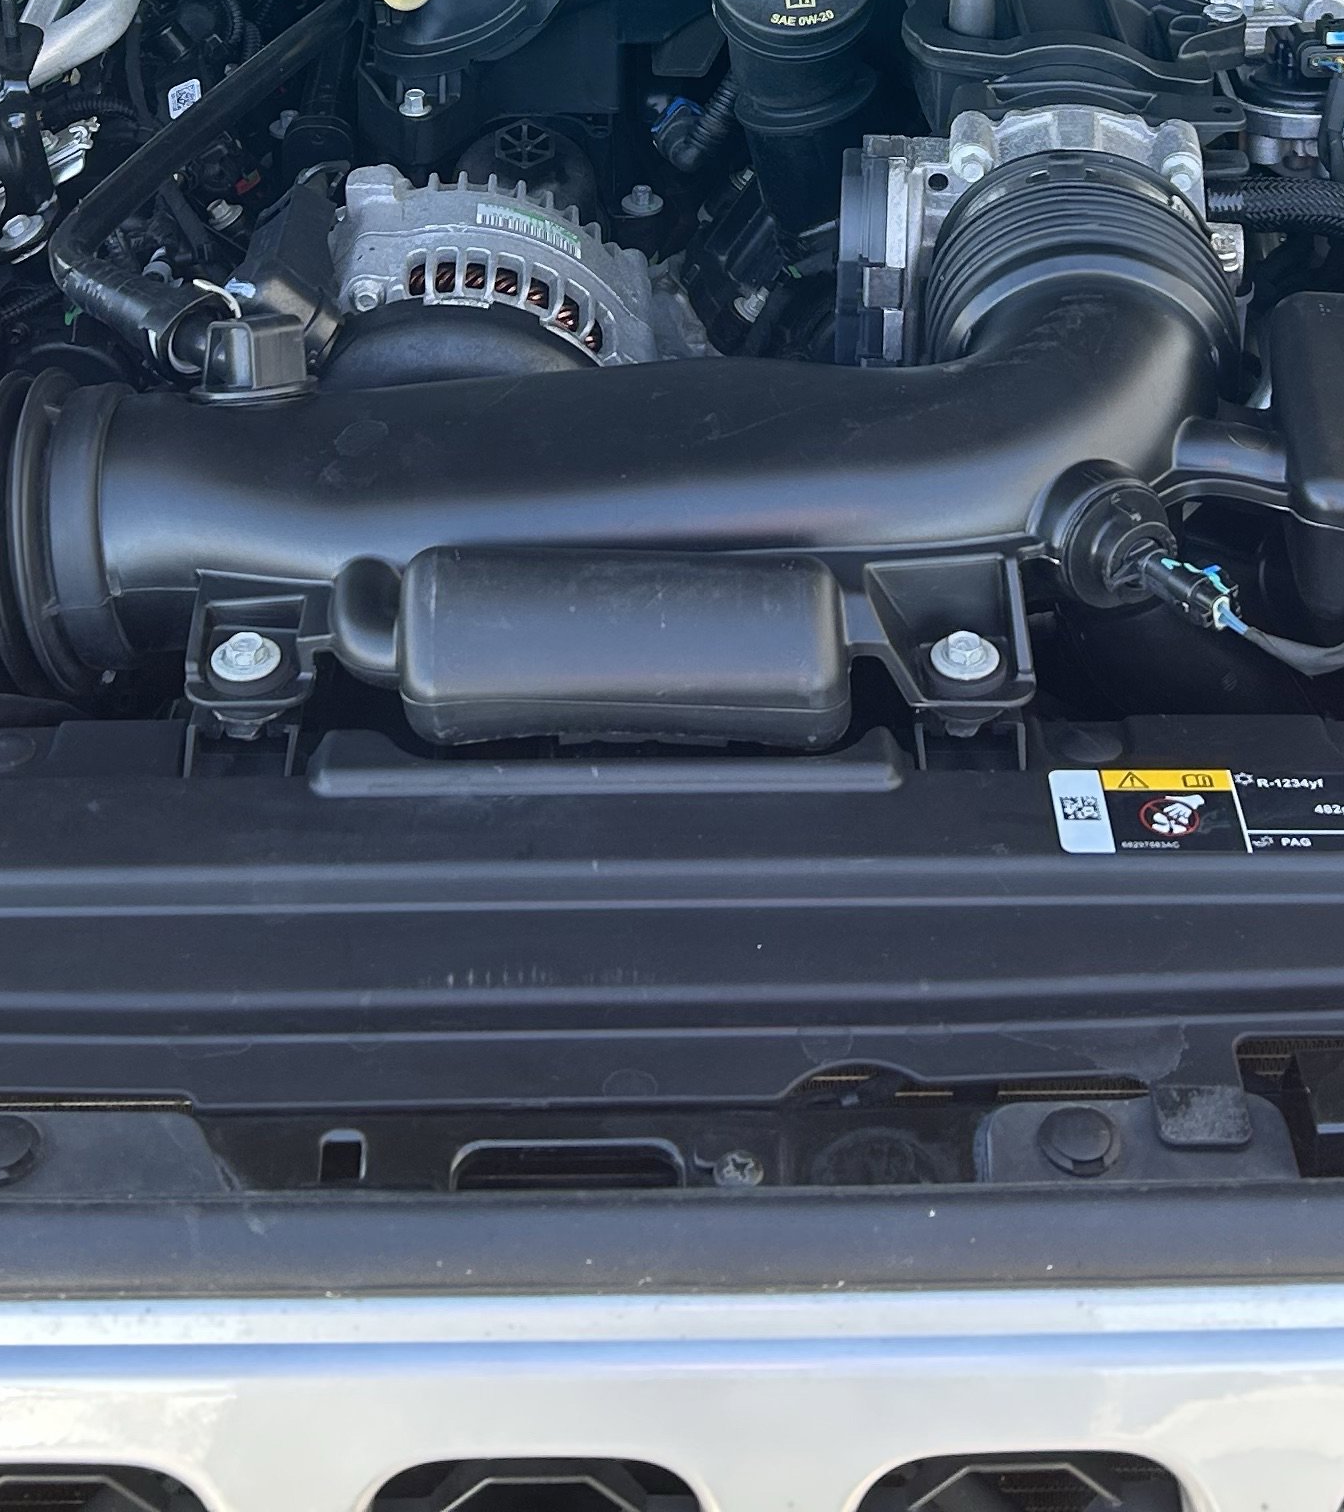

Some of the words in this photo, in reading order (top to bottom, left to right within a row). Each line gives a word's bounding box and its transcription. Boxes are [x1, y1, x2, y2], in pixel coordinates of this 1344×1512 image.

[770, 13, 797, 27] SAE
[798, 9, 835, 26] 0W-20
[1280, 837, 1312, 847] PAG
